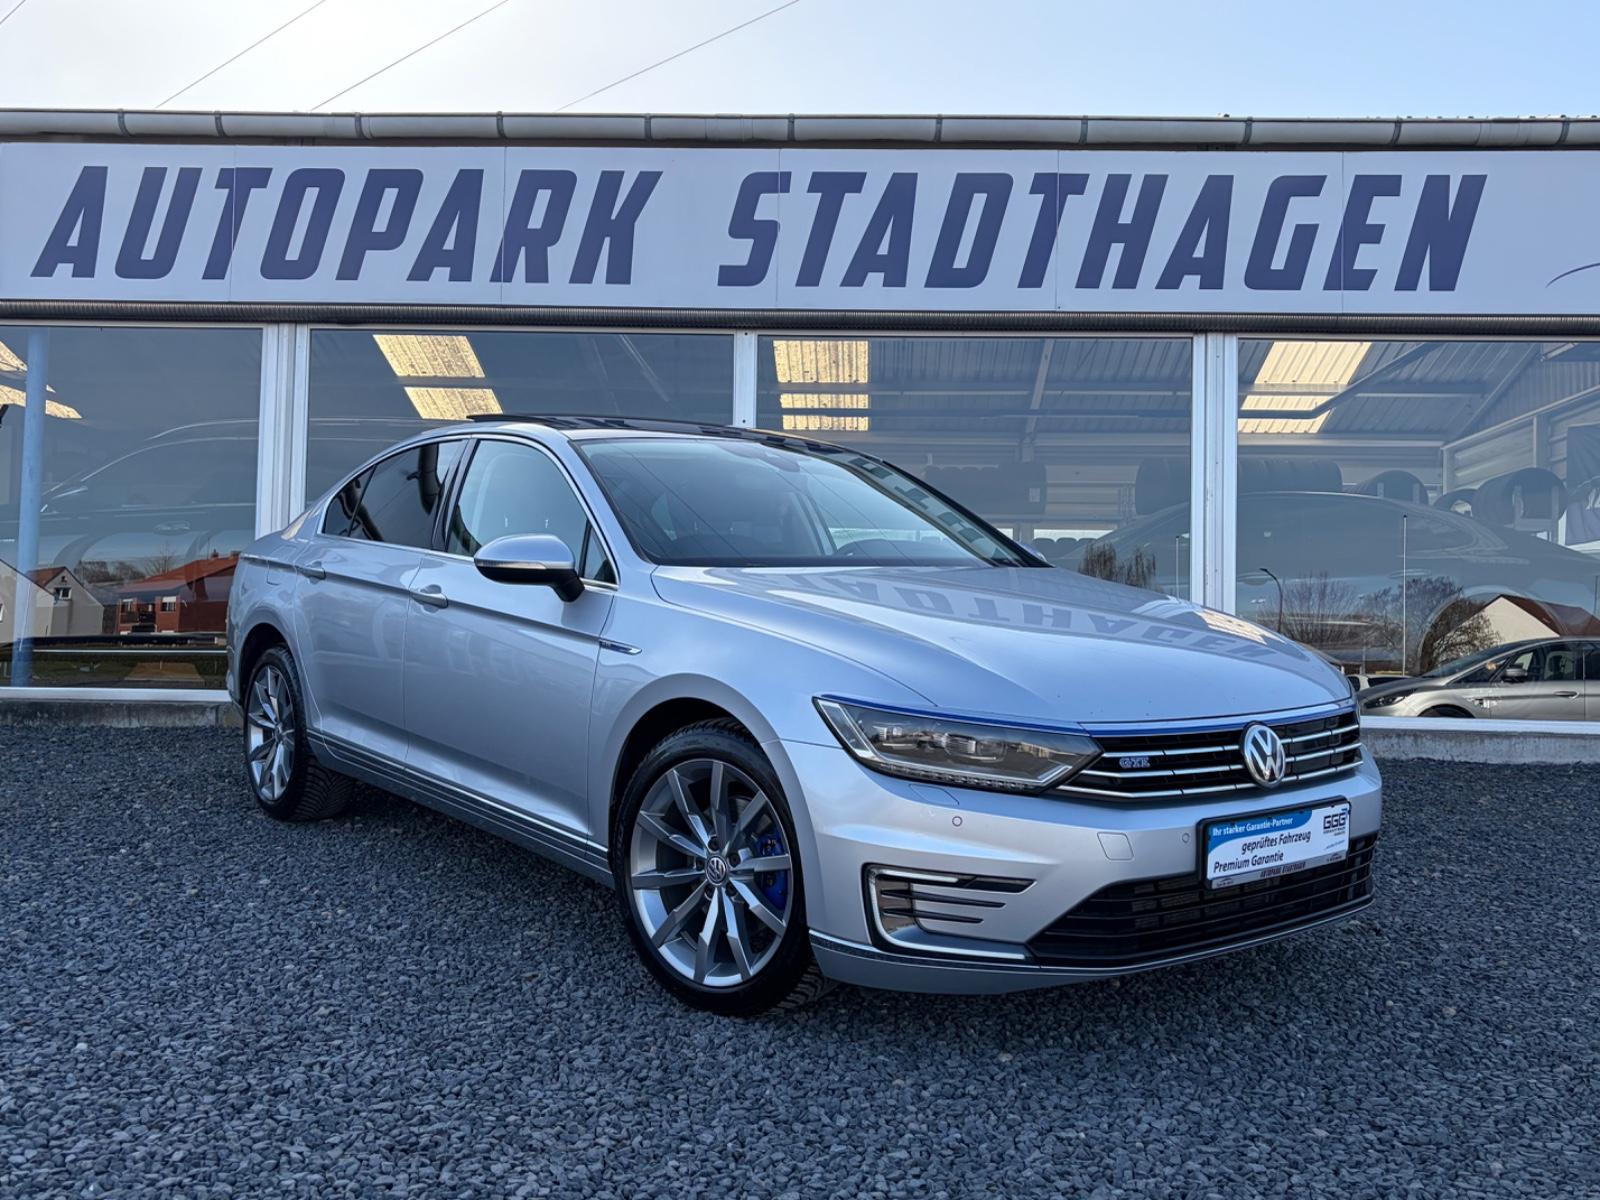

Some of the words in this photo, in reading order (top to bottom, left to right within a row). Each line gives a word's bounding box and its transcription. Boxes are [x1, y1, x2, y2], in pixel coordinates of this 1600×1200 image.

[30, 165, 662, 285] AUTOPARK
[717, 170, 1488, 291] STADTHAGEN
[1213, 827, 1223, 837] Ihr
[1223, 823, 1245, 835] starker
[1246, 817, 1294, 832] Garantie-Partner
[1323, 812, 1347, 830] GGG
[1241, 834, 1278, 855] geprüftes
[1278, 830, 1312, 846] Fahrzeug
[1213, 858, 1250, 873] Premium
[1251, 851, 1284, 867] Garantie
